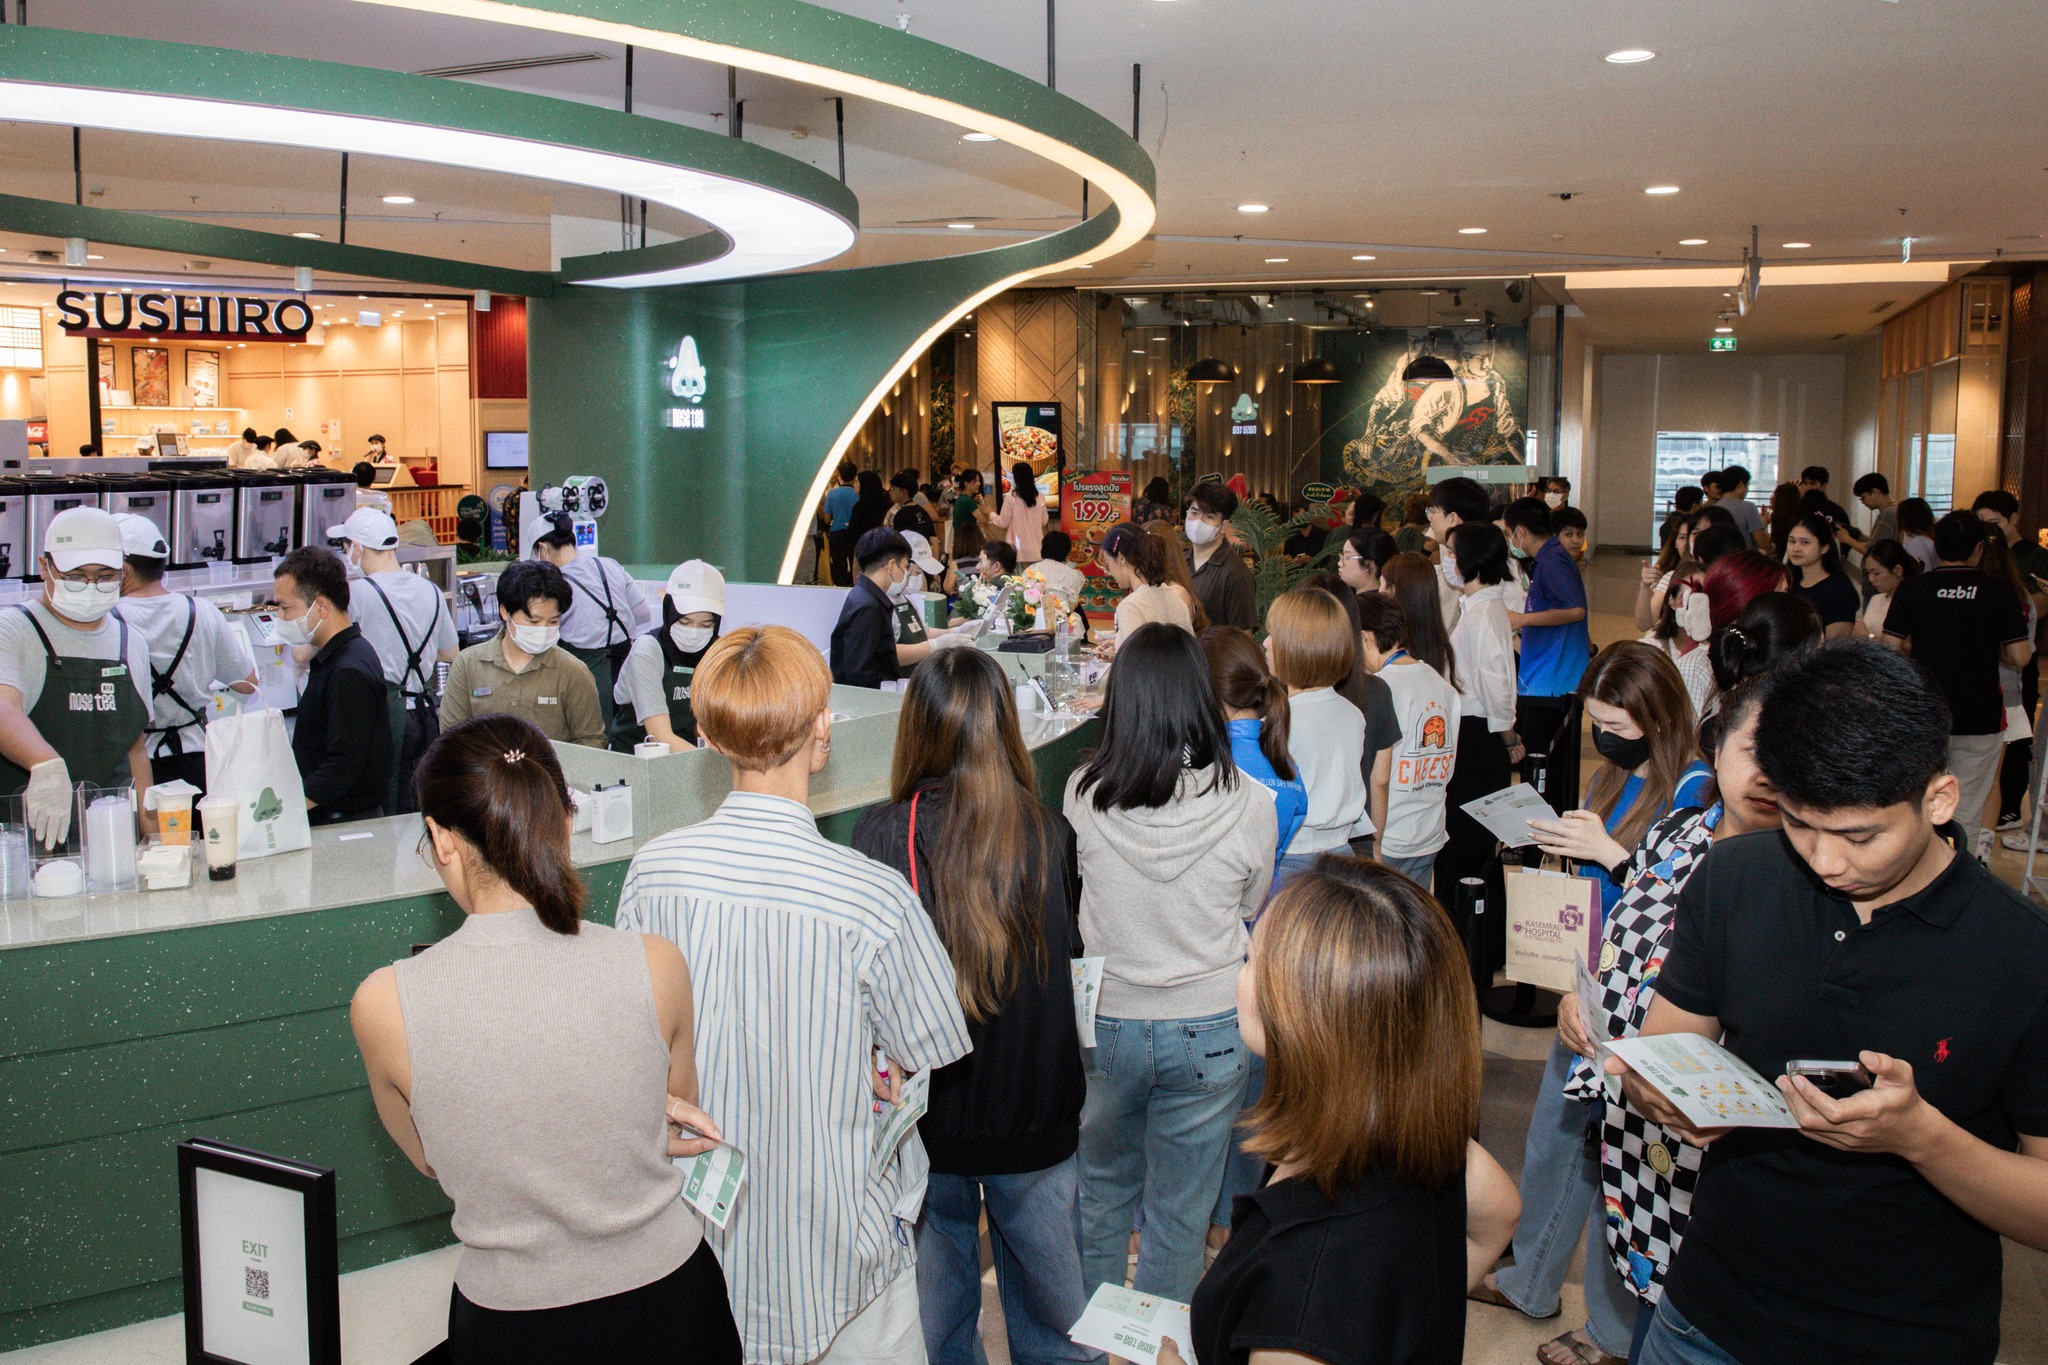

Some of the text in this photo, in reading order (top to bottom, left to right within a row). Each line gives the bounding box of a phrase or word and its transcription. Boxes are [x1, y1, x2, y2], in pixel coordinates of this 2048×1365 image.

[56, 290, 314, 337] SUSHIRO
[1072, 500, 1120, 521] 199.-
[1937, 585, 1978, 600] azbil
[69, 692, 117, 711] nose tea
[1524, 927, 1562, 940] HOSPITAL
[1525, 920, 1563, 932] KASEMRAD
[242, 1239, 268, 1258] EXIT
[1123, 1334, 1137, 1348] tea
[1137, 1340, 1157, 1355] nose
